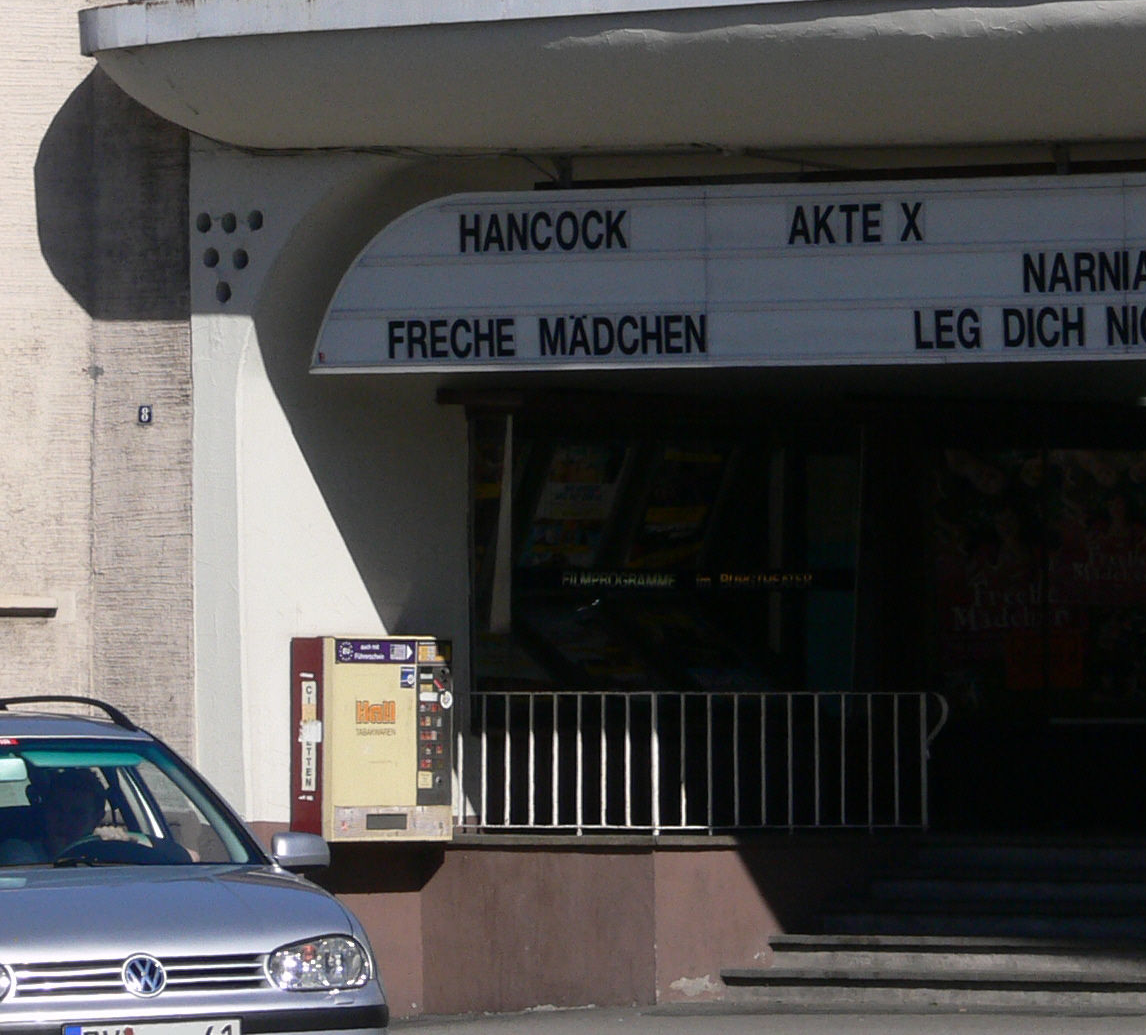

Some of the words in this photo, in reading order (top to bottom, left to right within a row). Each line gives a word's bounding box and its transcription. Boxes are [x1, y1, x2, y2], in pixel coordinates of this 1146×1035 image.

[459, 209, 628, 253] HANCOCK
[787, 202, 883, 245] AKTE
[900, 201, 924, 242] X
[387, 318, 516, 360] FRECHE
[538, 314, 708, 357] MÄDCHEN
[913, 307, 982, 350] LEG
[1002, 306, 1086, 349] DICH
